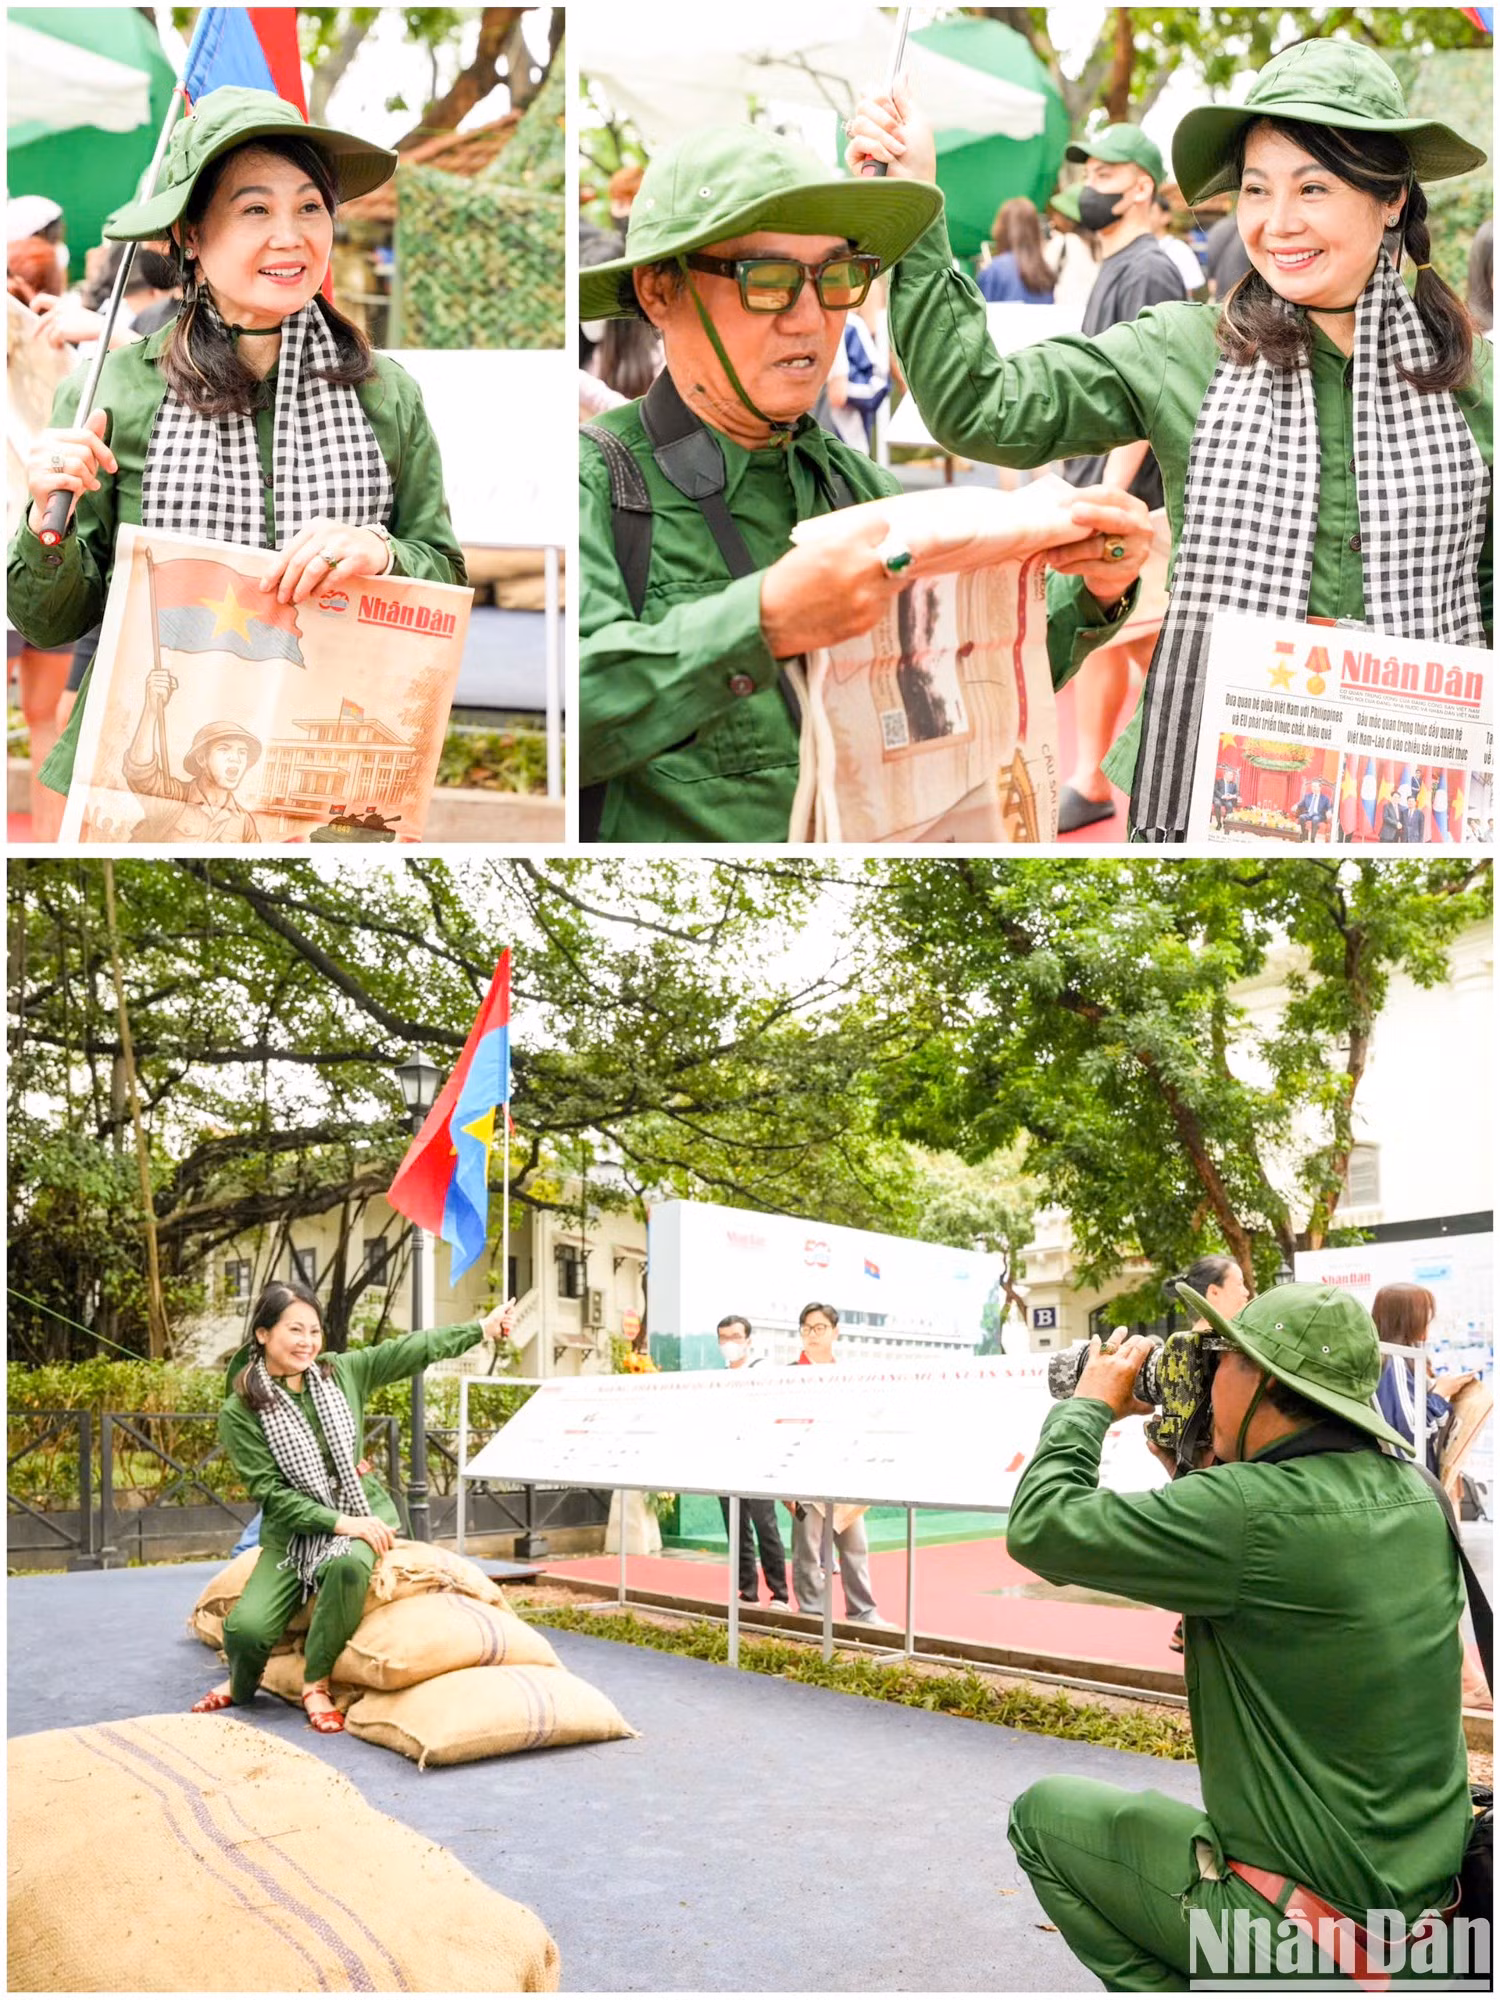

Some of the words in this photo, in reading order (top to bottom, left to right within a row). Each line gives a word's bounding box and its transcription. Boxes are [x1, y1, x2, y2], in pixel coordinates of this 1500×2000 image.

[358, 595, 414, 626] Nhân
[416, 606, 456, 634] Dân
[1341, 650, 1419, 690] Nhân
[1424, 662, 1484, 700] Dân
[1237, 696, 1252, 708] quan
[1286, 702, 1299, 716] Nam
[1310, 706, 1343, 723] Philippines
[1240, 714, 1248, 727] EU
[1382, 718, 1396, 731] quan
[1440, 726, 1454, 741] quan
[1036, 1310, 1052, 1326] B
